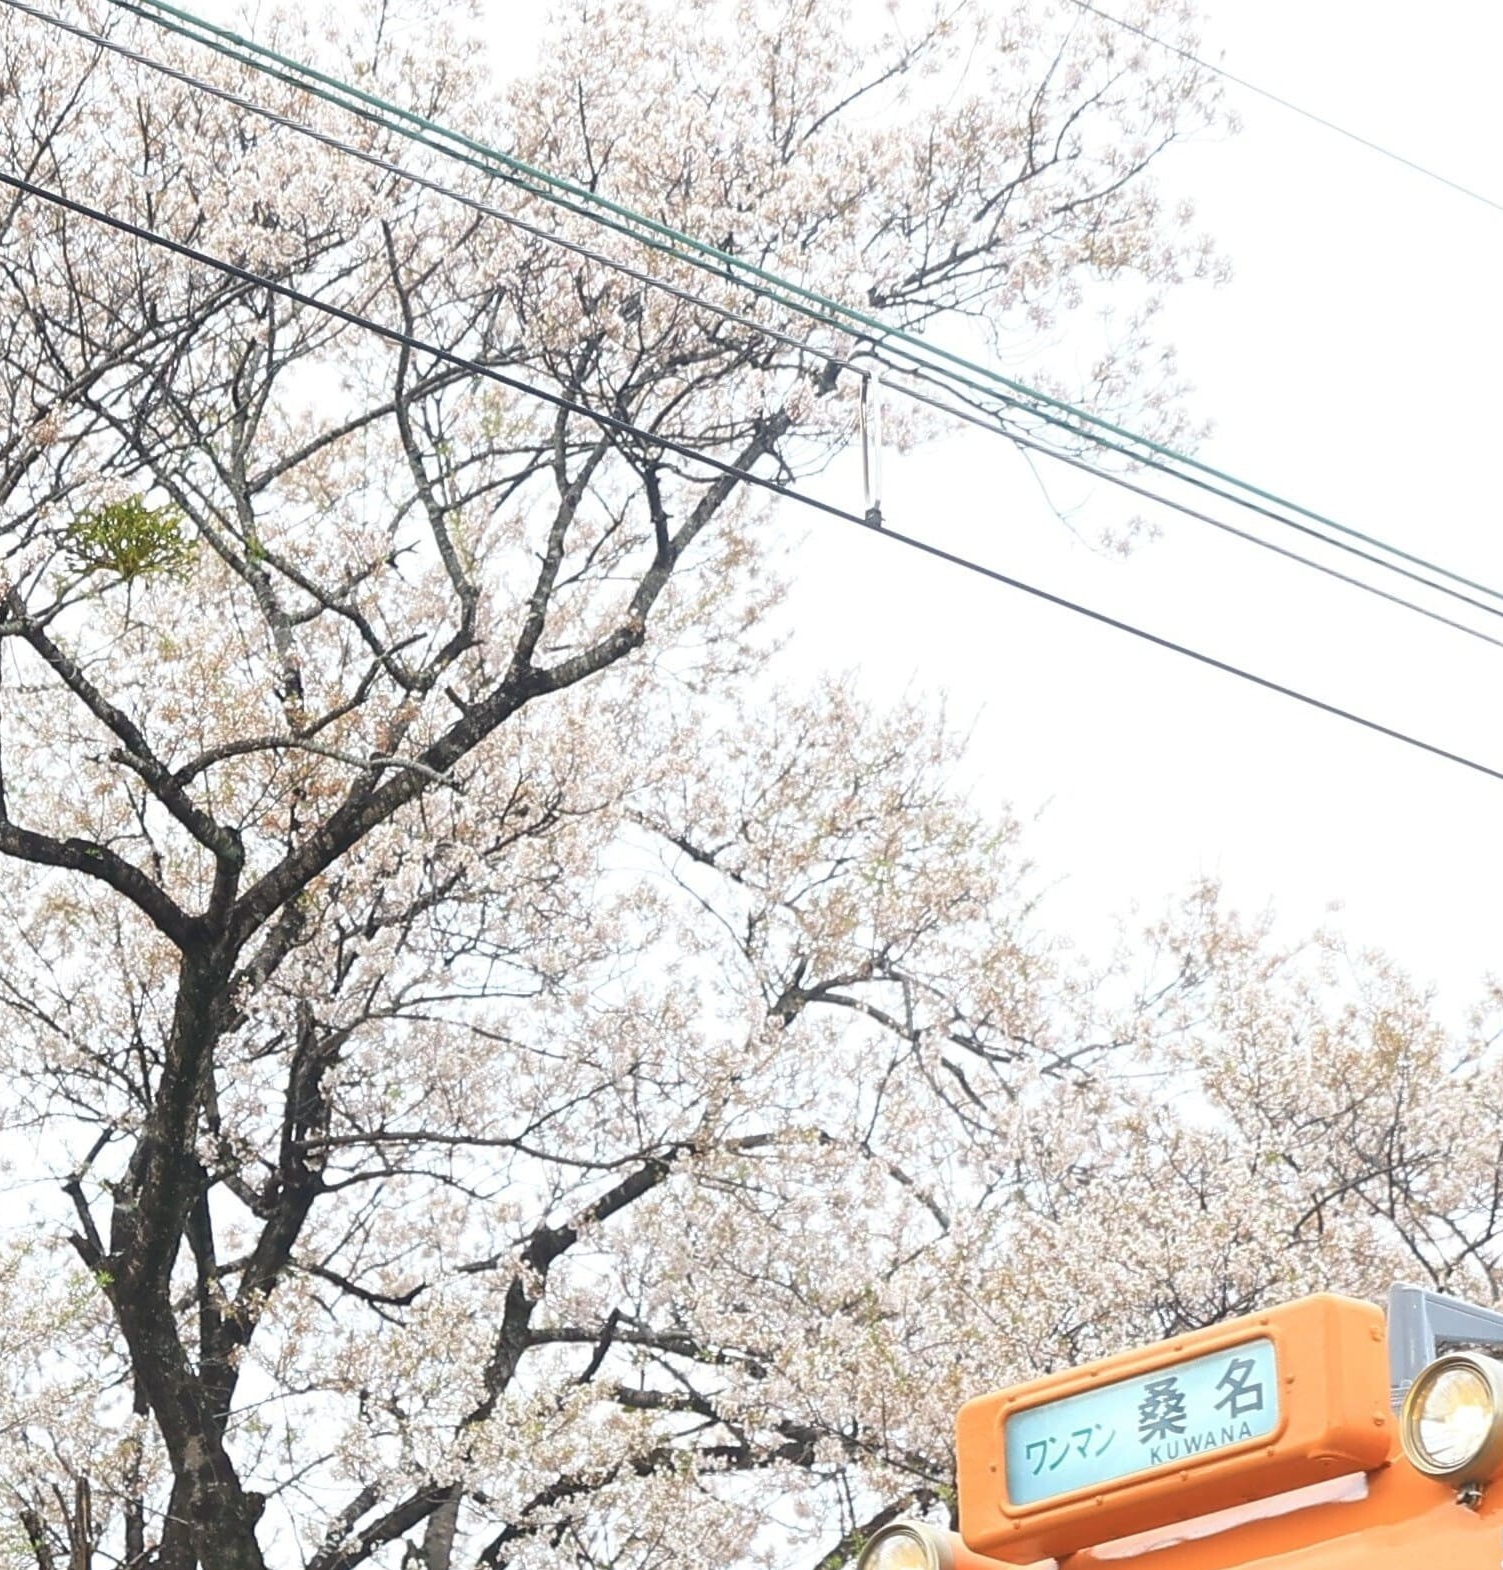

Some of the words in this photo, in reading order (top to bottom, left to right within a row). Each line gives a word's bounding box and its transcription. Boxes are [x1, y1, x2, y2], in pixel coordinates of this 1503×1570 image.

[1138, 1358, 1264, 1444] 桑名
[1026, 1423, 1116, 1475] ワンマン
[1150, 1421, 1252, 1466] KUWANA
